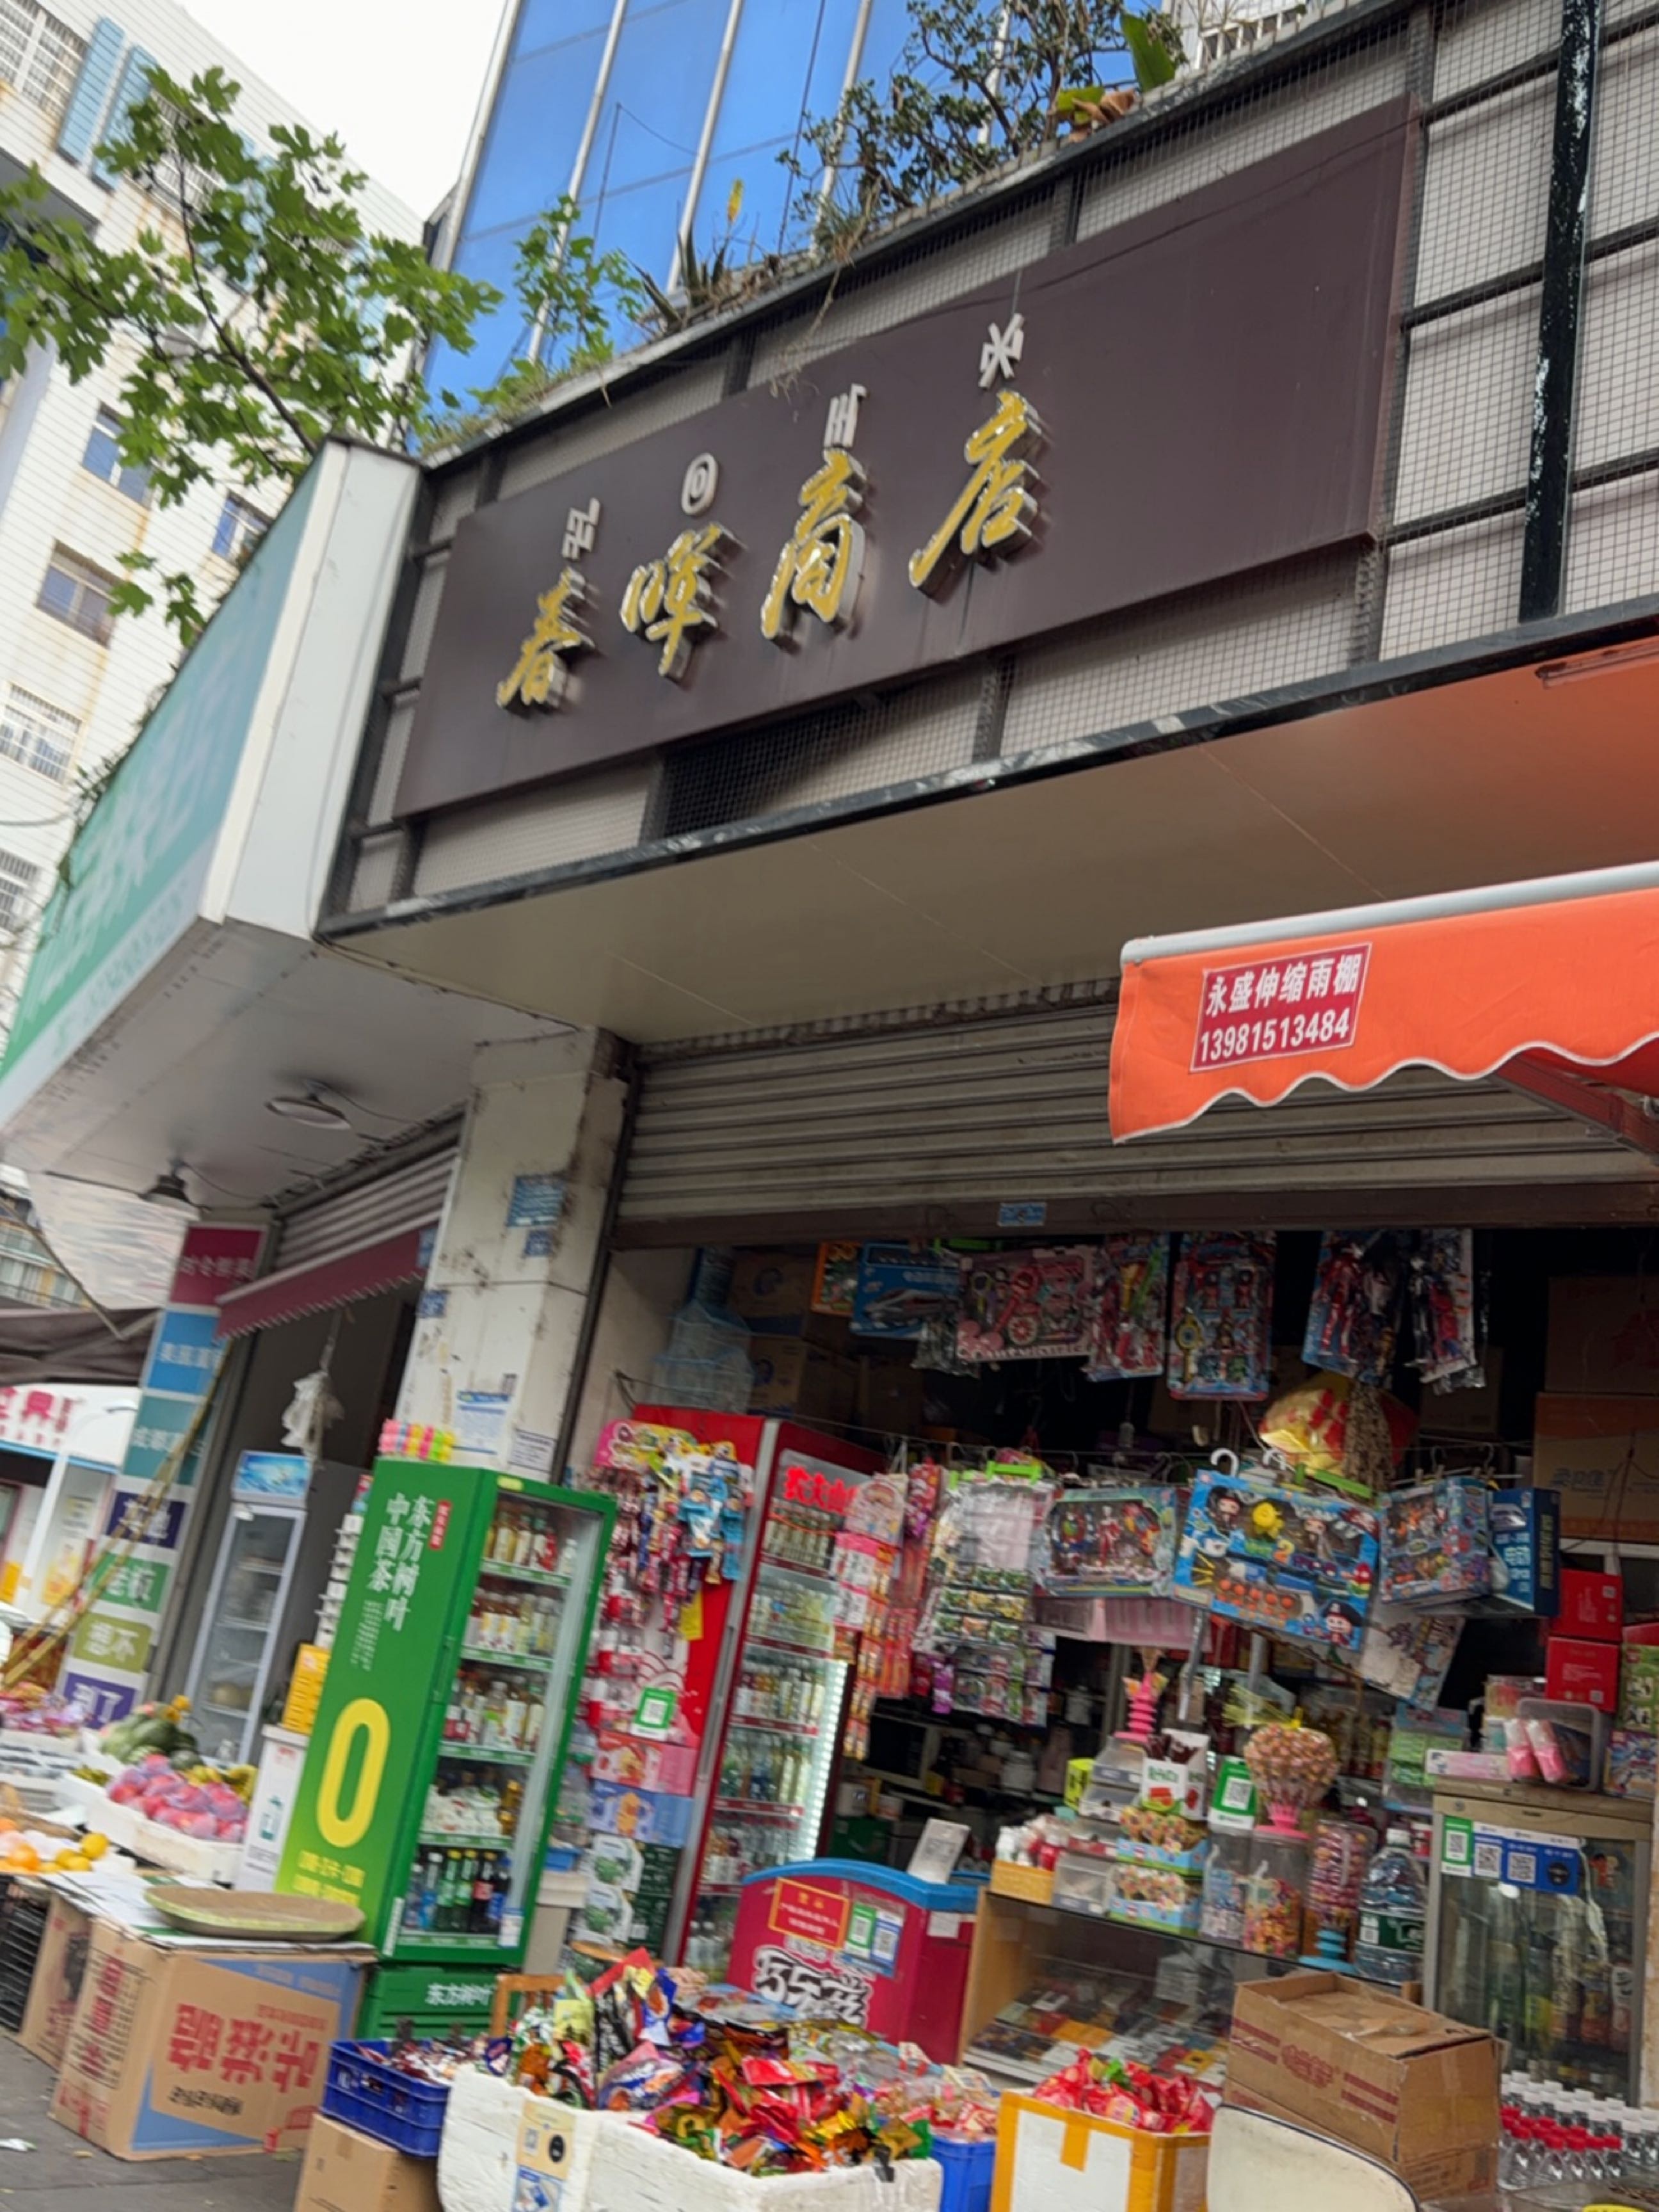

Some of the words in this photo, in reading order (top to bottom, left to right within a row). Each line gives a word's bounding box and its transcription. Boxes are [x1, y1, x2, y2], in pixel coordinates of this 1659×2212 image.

[497, 390, 1050, 708] 春晖商店
[1199, 1007, 1351, 1062] 13981513484
[1206, 953, 1360, 1018] 永盛伸缩雨棚
[365, 1491, 410, 1592] 中国茶
[384, 1495, 437, 1631] 东方树叶
[316, 1697, 392, 1848] 0
